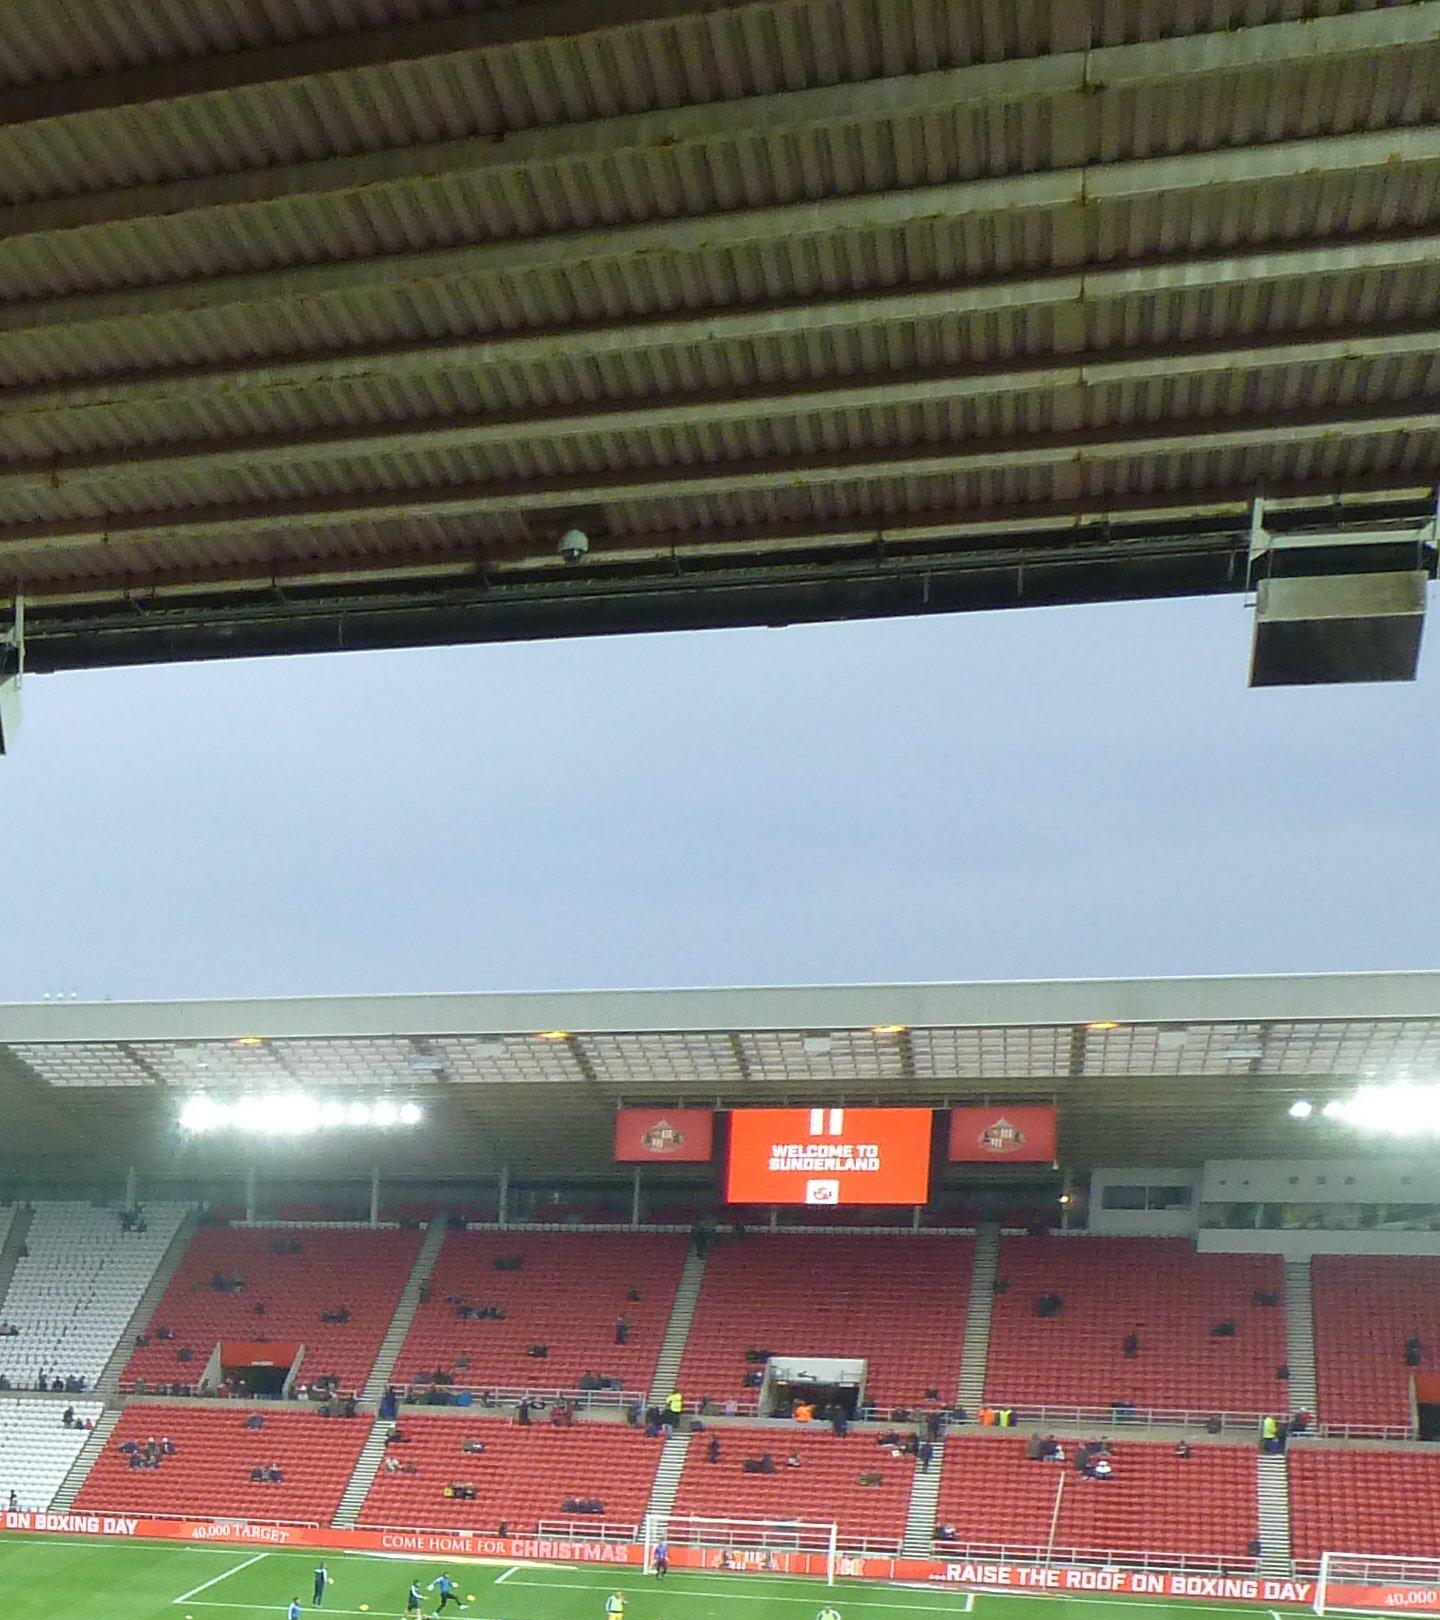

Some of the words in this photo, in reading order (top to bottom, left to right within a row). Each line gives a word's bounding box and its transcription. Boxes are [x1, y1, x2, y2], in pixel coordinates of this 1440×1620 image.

[771, 1144, 854, 1158] WELCOME
[856, 1144, 879, 1158] TO
[768, 1158, 880, 1171] SUNDERLAND
[6, 1512, 30, 1529] ON
[35, 1514, 100, 1533] BOXING
[103, 1518, 138, 1536] DAY
[232, 1524, 289, 1543] TARGET
[382, 1535, 424, 1549] COME
[429, 1537, 472, 1552] HOME
[477, 1539, 504, 1554] FOR
[511, 1539, 628, 1562] CHRISTMAS
[1015, 1567, 1060, 1588] THE
[1066, 1570, 1125, 1591] ROOF
[1131, 1574, 1164, 1592] ON
[1171, 1576, 1257, 1598] BOXING
[1264, 1581, 1312, 1601] DAY
